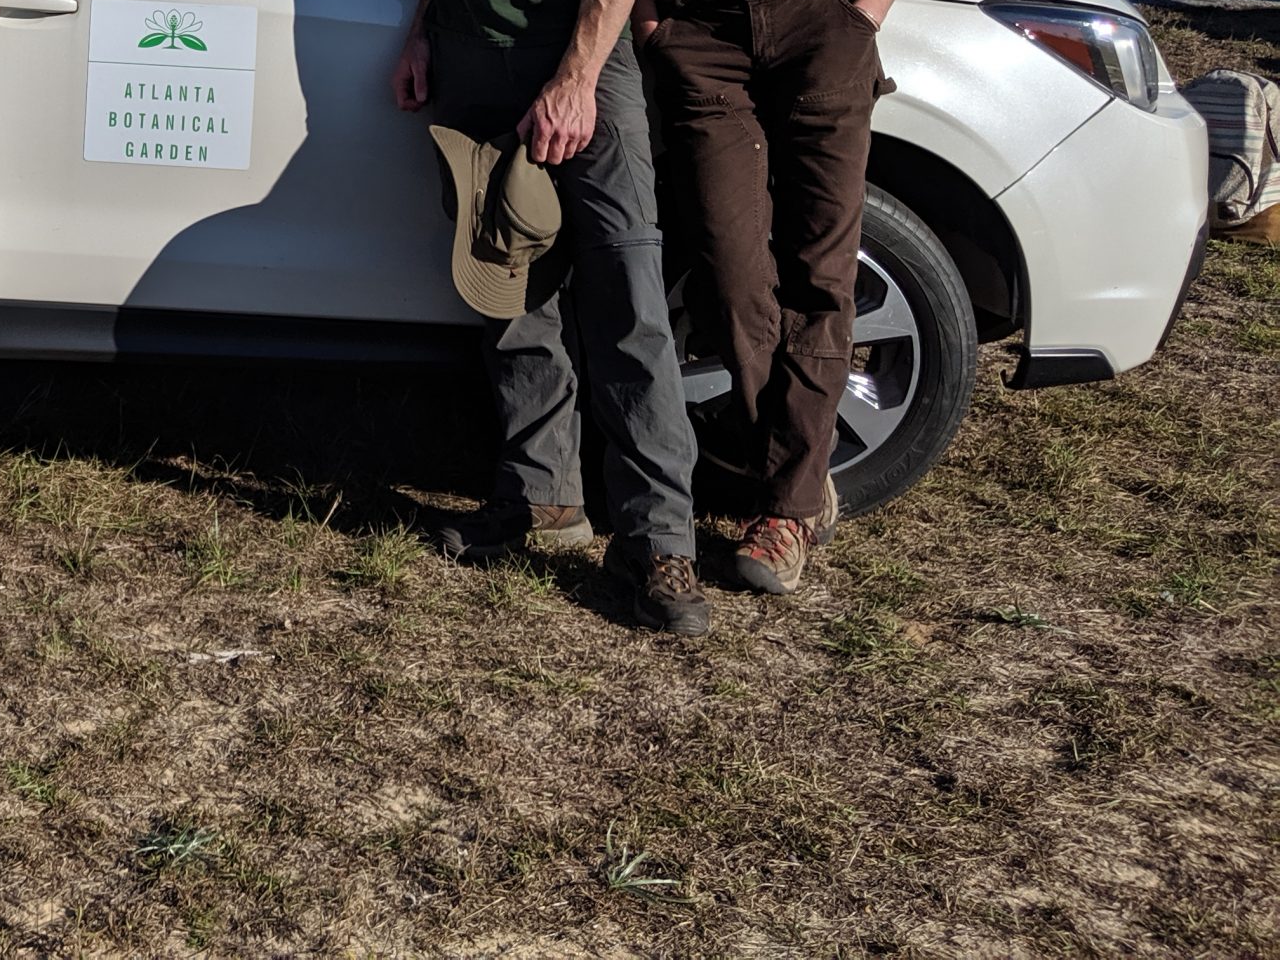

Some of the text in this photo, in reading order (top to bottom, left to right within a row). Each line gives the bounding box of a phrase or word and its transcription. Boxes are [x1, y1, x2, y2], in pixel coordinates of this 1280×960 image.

[124, 82, 215, 104] ATLANTA
[108, 111, 229, 134] BOTANICAL
[125, 141, 208, 162] GARDEN
